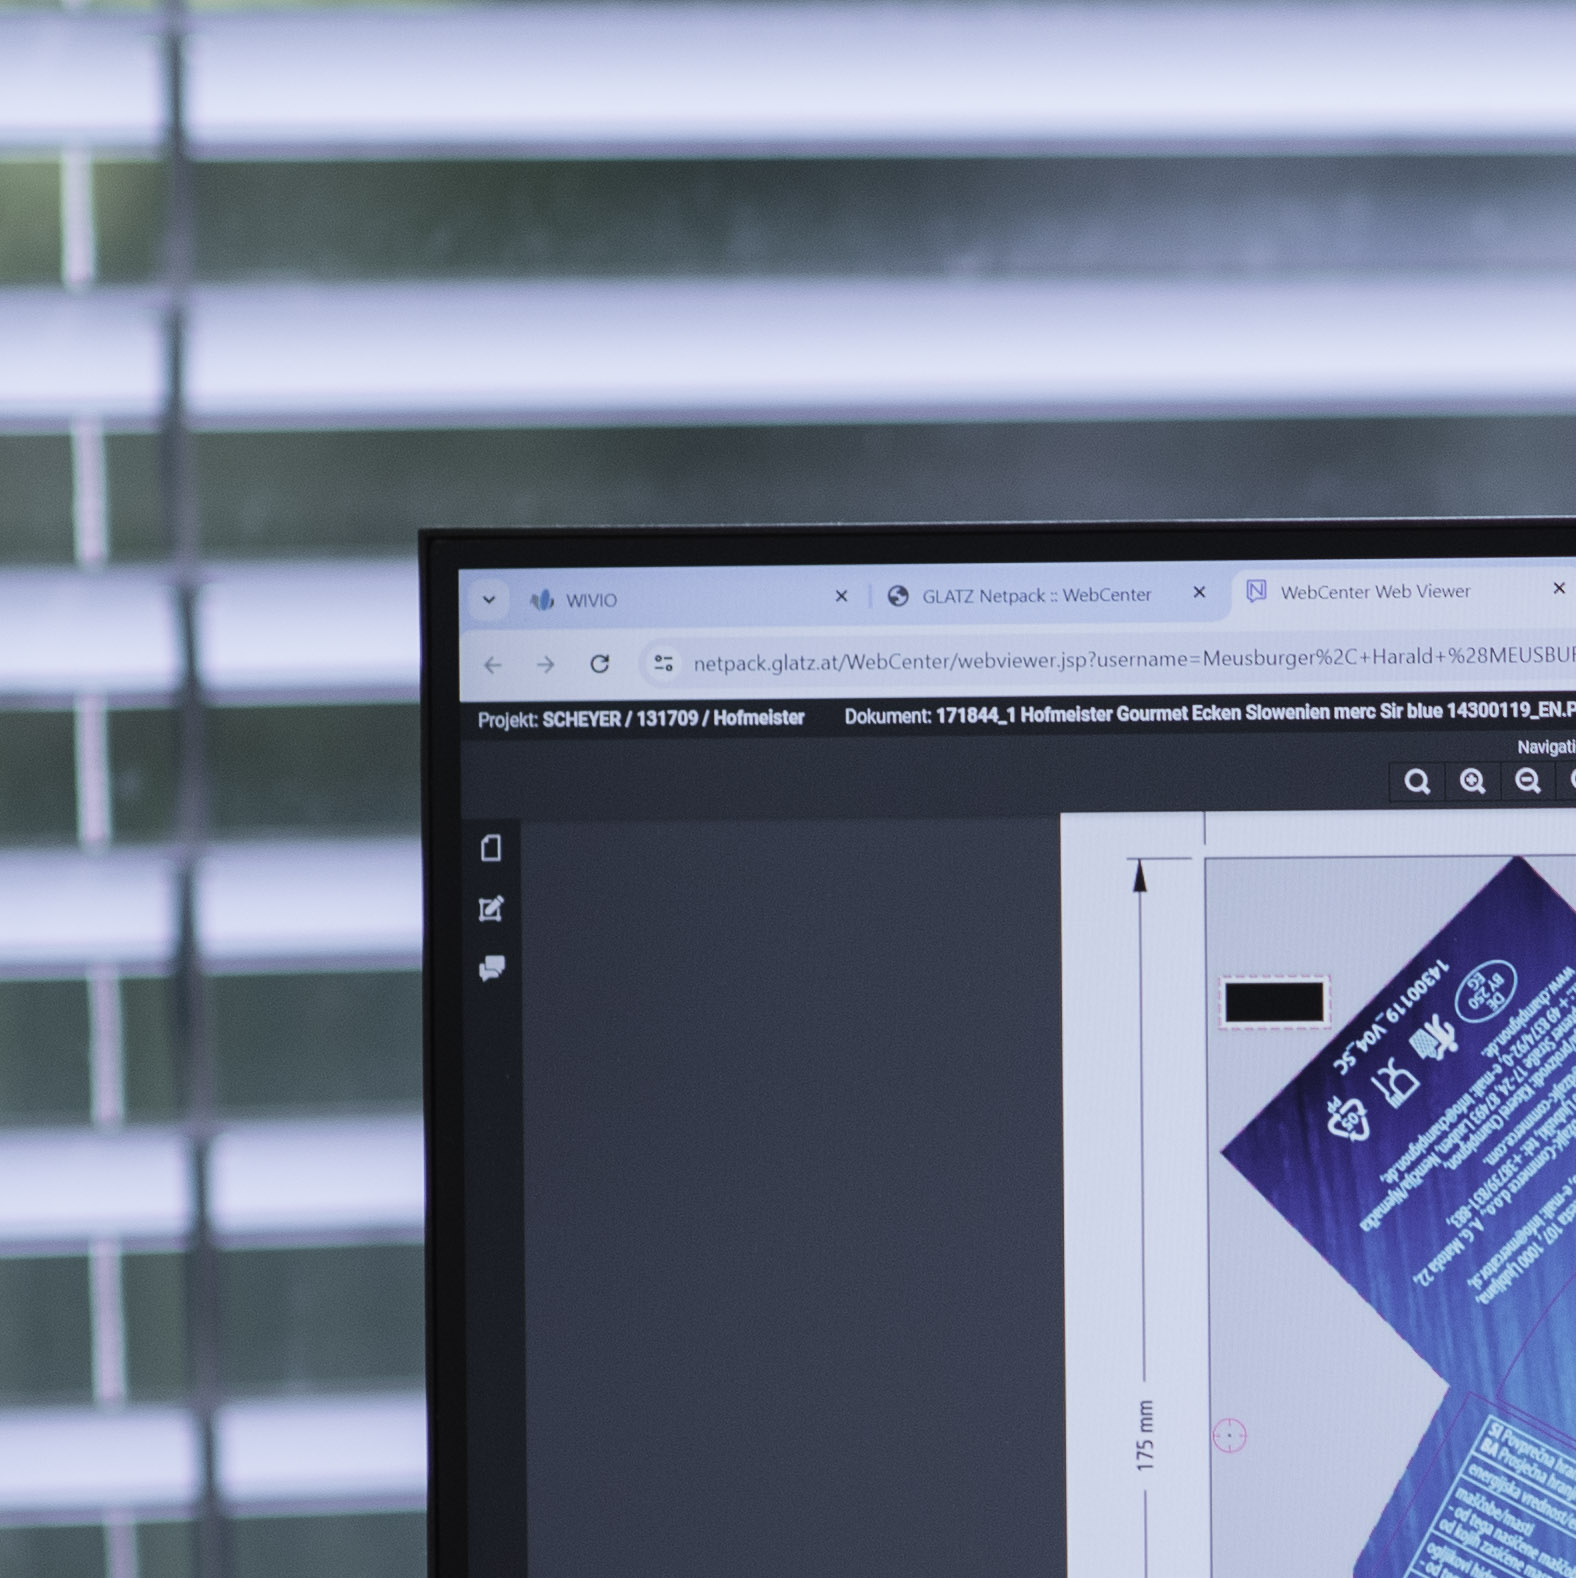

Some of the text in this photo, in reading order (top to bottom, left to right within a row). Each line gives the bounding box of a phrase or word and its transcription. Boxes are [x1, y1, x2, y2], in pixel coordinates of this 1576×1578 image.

[566, 593, 617, 608] WIVIO
[922, 588, 974, 603] GLATZ
[979, 587, 1045, 606] Netpack
[1062, 586, 1151, 602] WebCenter
[1281, 582, 1471, 599] WebCenter Web Viewer
[478, 711, 537, 731] Projekt:
[542, 708, 622, 729] SCHEYER
[637, 709, 698, 726] 131709
[713, 708, 805, 725] Hofmeister
[844, 707, 931, 724] Dokument:
[936, 706, 1014, 726] 171844_1
[1020, 705, 1113, 723] Hofmeister
[1116, 704, 1188, 722] Gourmet
[1191, 704, 1241, 721] Ecken
[1245, 703, 1330, 721] Slowenien
[1333, 706, 1376, 720] merc
[1379, 702, 1404, 719] Sir
[1406, 702, 1443, 719] blue
[1466, 971, 1485, 991] EG
[1467, 972, 1505, 1010] BY 250
[1486, 991, 1506, 1011] DE
[1331, 958, 1451, 1076] 14300119_V04_SC
[1136, 1400, 1153, 1471] 175 mm
